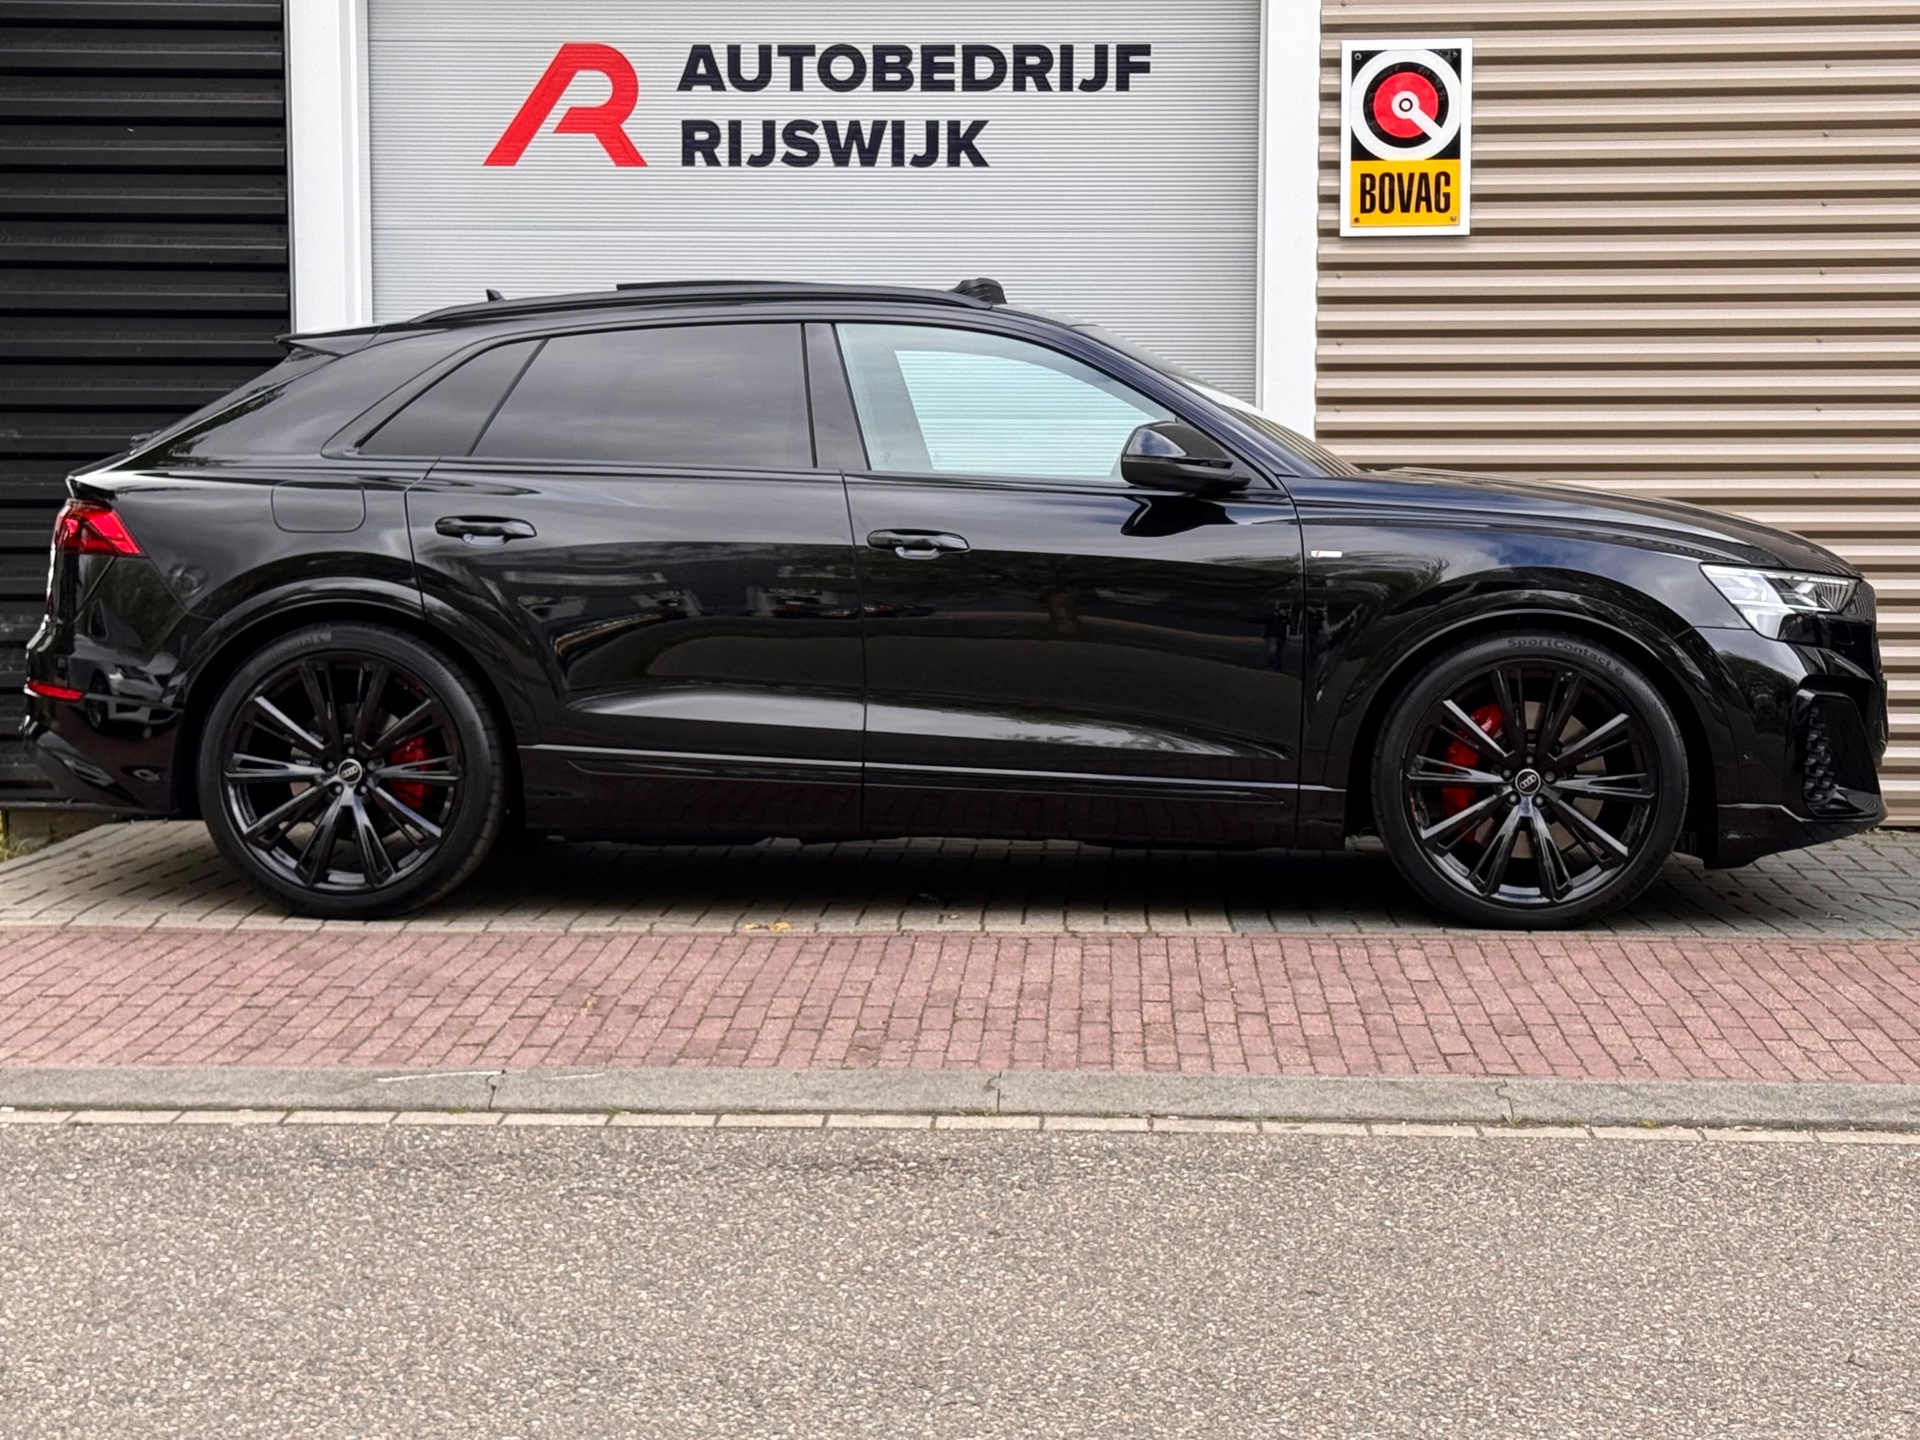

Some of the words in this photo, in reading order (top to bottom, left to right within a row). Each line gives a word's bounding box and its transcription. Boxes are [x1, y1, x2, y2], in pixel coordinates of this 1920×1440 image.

[676, 43, 1152, 92] AUTOBEDRIJF
[681, 119, 990, 167] RIJSWIJK
[1360, 171, 1451, 214] BOVAG
[1507, 638, 1612, 668] SportContact
